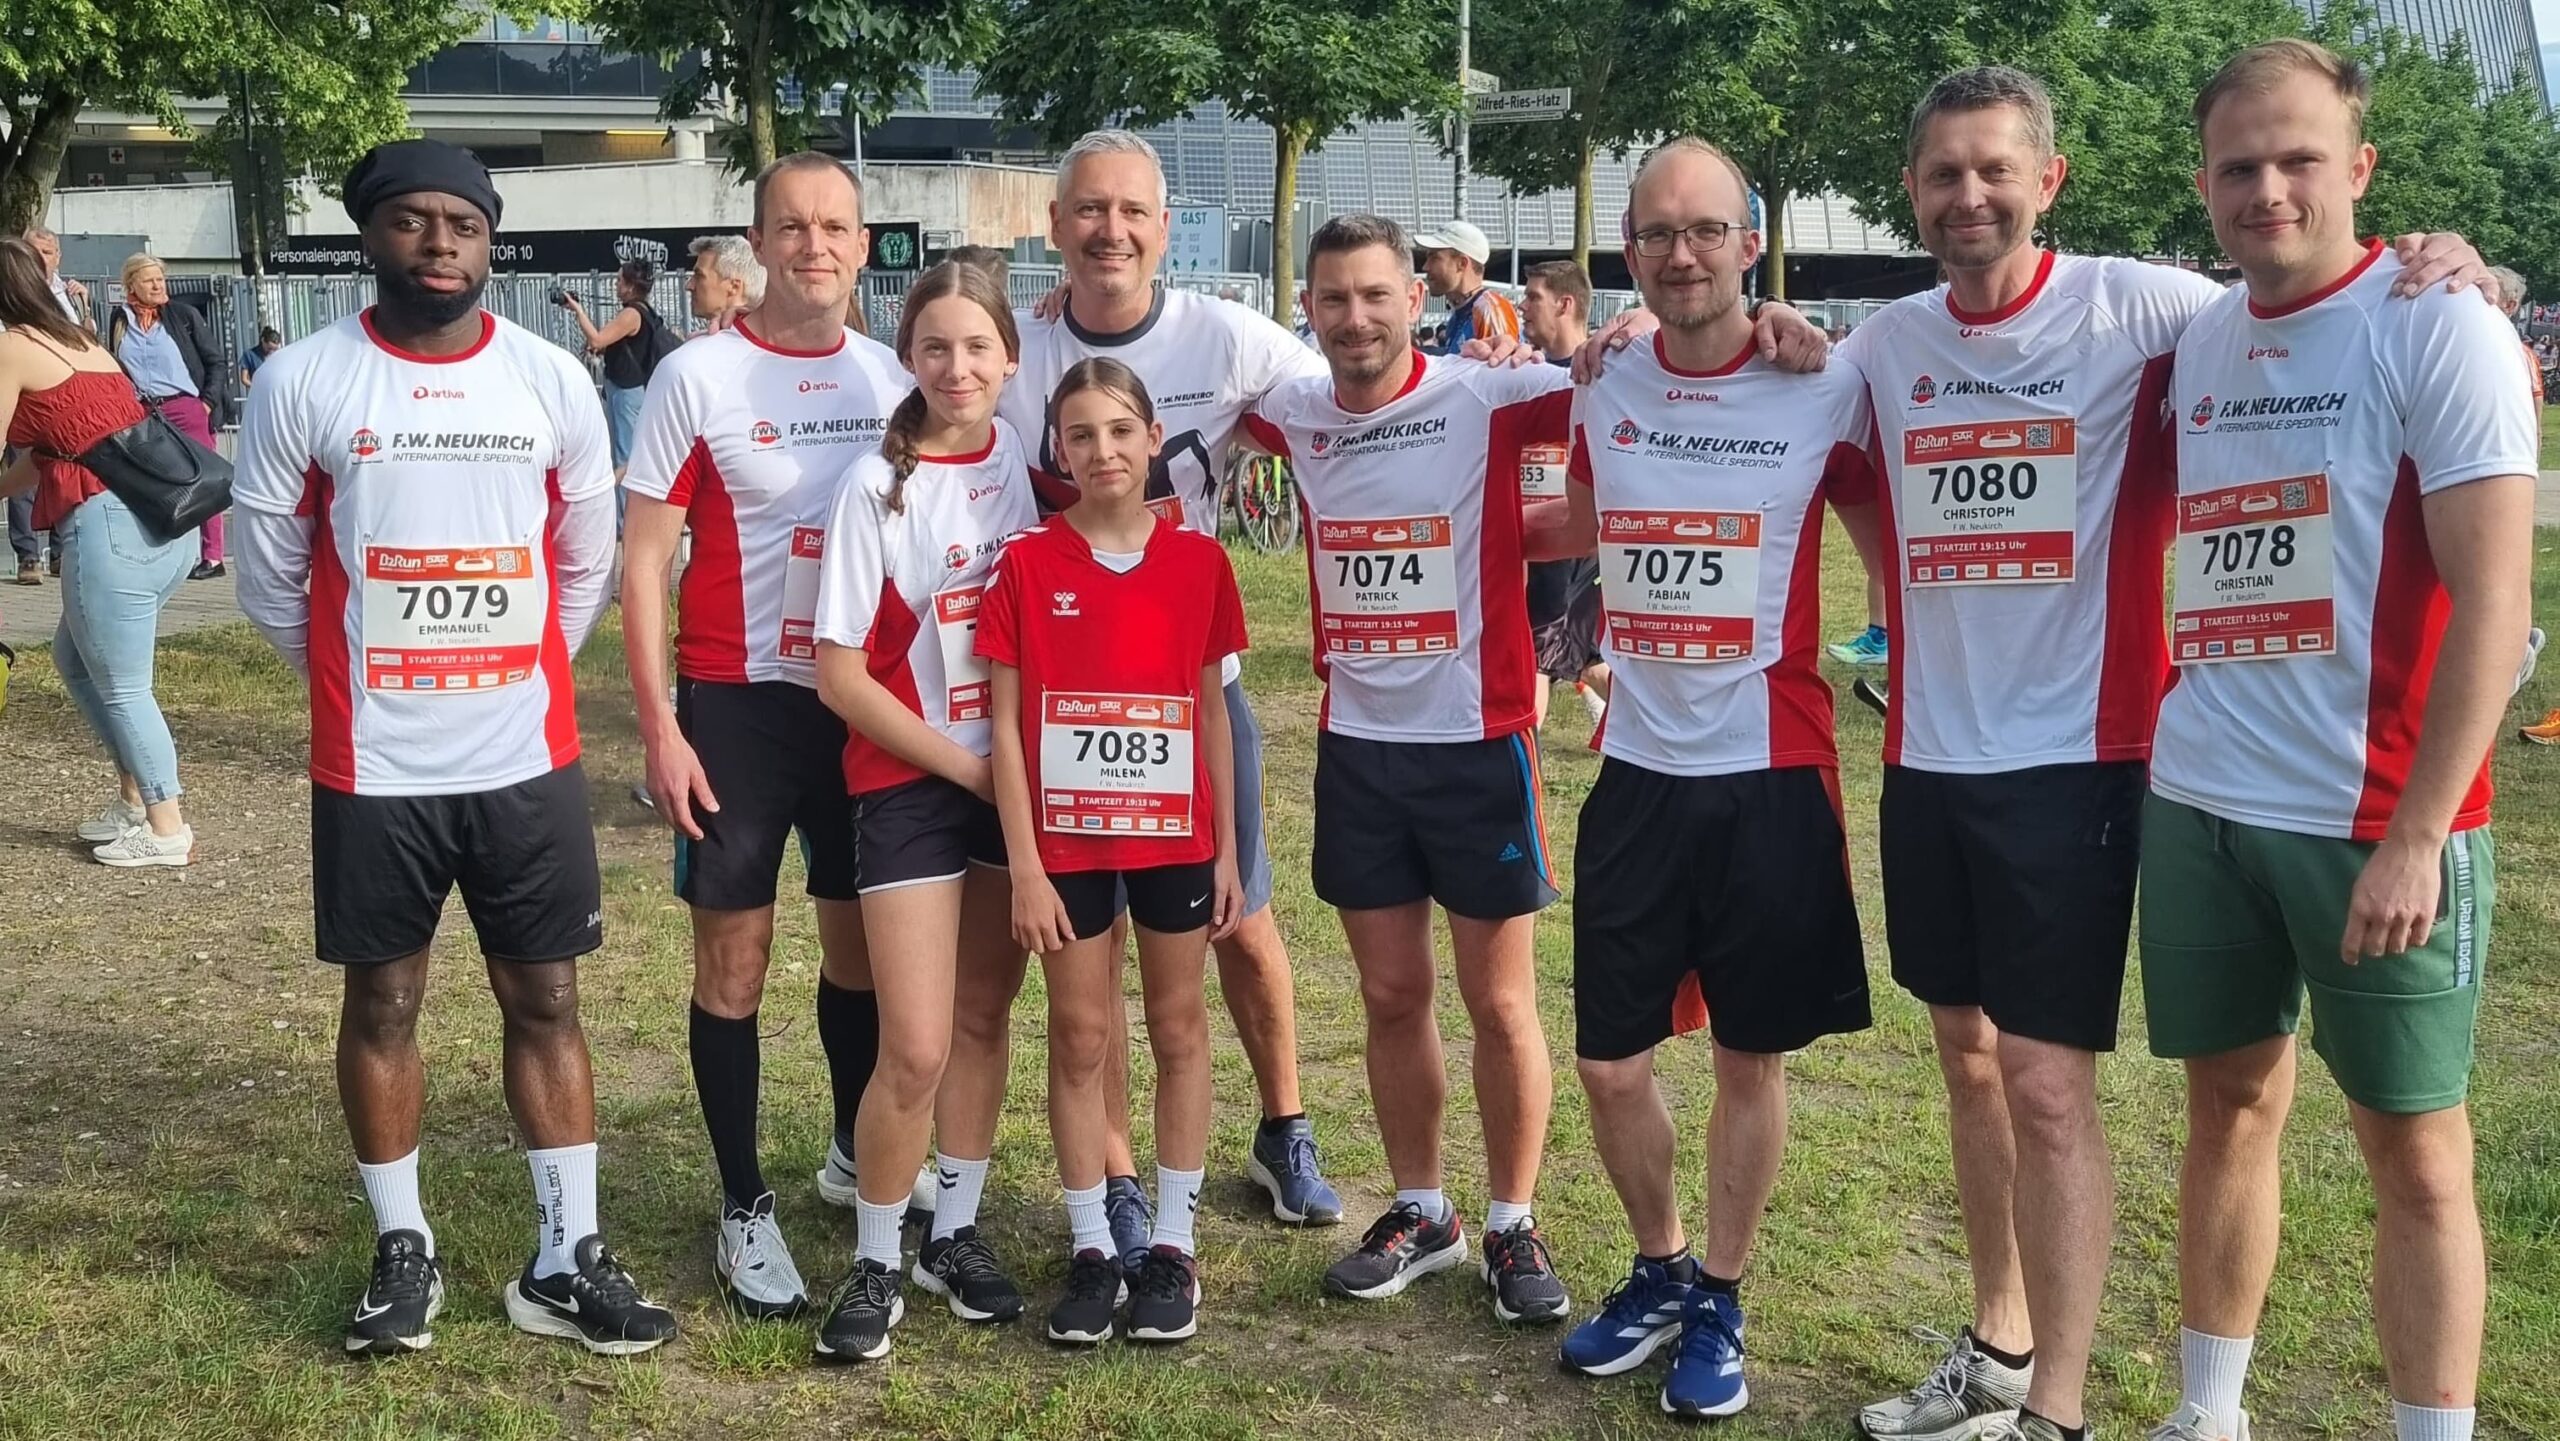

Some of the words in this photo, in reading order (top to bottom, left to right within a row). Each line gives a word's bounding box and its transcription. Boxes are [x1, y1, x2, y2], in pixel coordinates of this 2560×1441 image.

[1181, 212, 1207, 224] GAST
[270, 248, 360, 266] Personaleingang
[490, 245, 516, 260] TOR
[520, 245, 533, 260] 10
[2256, 348, 2288, 358] artiva
[431, 388, 465, 399] artiva
[813, 382, 838, 390] artiva
[1942, 381, 1973, 396] F.W.
[1684, 392, 1718, 402] artiva
[2219, 400, 2248, 418] F.W.
[2250, 392, 2348, 416] NEUKIRCH
[790, 421, 820, 436] F.W.
[1361, 417, 1446, 444] NEUKIRCH
[2214, 419, 2283, 432] INTERNATIONALE
[2284, 416, 2340, 430] SPEDITION
[751, 426, 780, 440] FWN
[1614, 424, 1640, 440] FWN
[350, 435, 381, 449] FWN
[392, 432, 431, 449] F.W.
[435, 433, 535, 452] NEUKIRCH
[792, 436, 861, 447] INTERNATIONALE
[1399, 435, 1446, 450] SPEDITION
[1648, 432, 1681, 448] F.W.
[1684, 437, 1789, 456] NEUKIRCH
[392, 452, 481, 463] INTERNATIONALE
[482, 453, 533, 464] SPEDITION
[1644, 448, 1726, 466] INTERNATIONALE
[1728, 458, 1784, 470] SPEDITION
[1928, 462, 2037, 504] 7080
[1943, 506, 2015, 520] CHRISTOPH
[1970, 522, 2002, 530] Neukirch
[1934, 542, 1976, 552] STARTZEIT
[1980, 542, 2006, 550] 19:15
[2009, 540, 2027, 550] Uhr
[2203, 525, 2295, 575] 7078
[1334, 553, 1424, 588] 7074
[1624, 548, 1722, 586] 7075
[2215, 574, 2274, 592] CHRISTIAN
[396, 584, 509, 620] 7079
[1356, 592, 1400, 602] PATRICK
[1648, 590, 1690, 600] FABIAN
[1662, 604, 1692, 612] Neukirch
[1344, 620, 1378, 629] STARTZEIT
[1381, 620, 1402, 628] 19:15
[1632, 620, 1668, 630] STARTZEIT
[1670, 622, 1694, 632] 19:15
[1696, 624, 1712, 632] Uhr
[2204, 614, 2243, 628] STARTZEIT
[2246, 613, 2270, 624] 19:15
[2273, 612, 2290, 622] Uhr
[418, 624, 491, 635] EMMANUEL
[408, 655, 457, 664] STARTZEIT
[460, 654, 485, 663] 19:15
[487, 654, 503, 662] Uhr
[1072, 730, 1170, 765] 7083
[1100, 768, 1147, 780] MILENA
[1079, 797, 1122, 806] STARTZEIT
[1126, 798, 1148, 806] 19:15
[1150, 798, 1162, 808] Uhr
[2460, 898, 2472, 940] URBAN
[2458, 940, 2472, 972] EDGE
